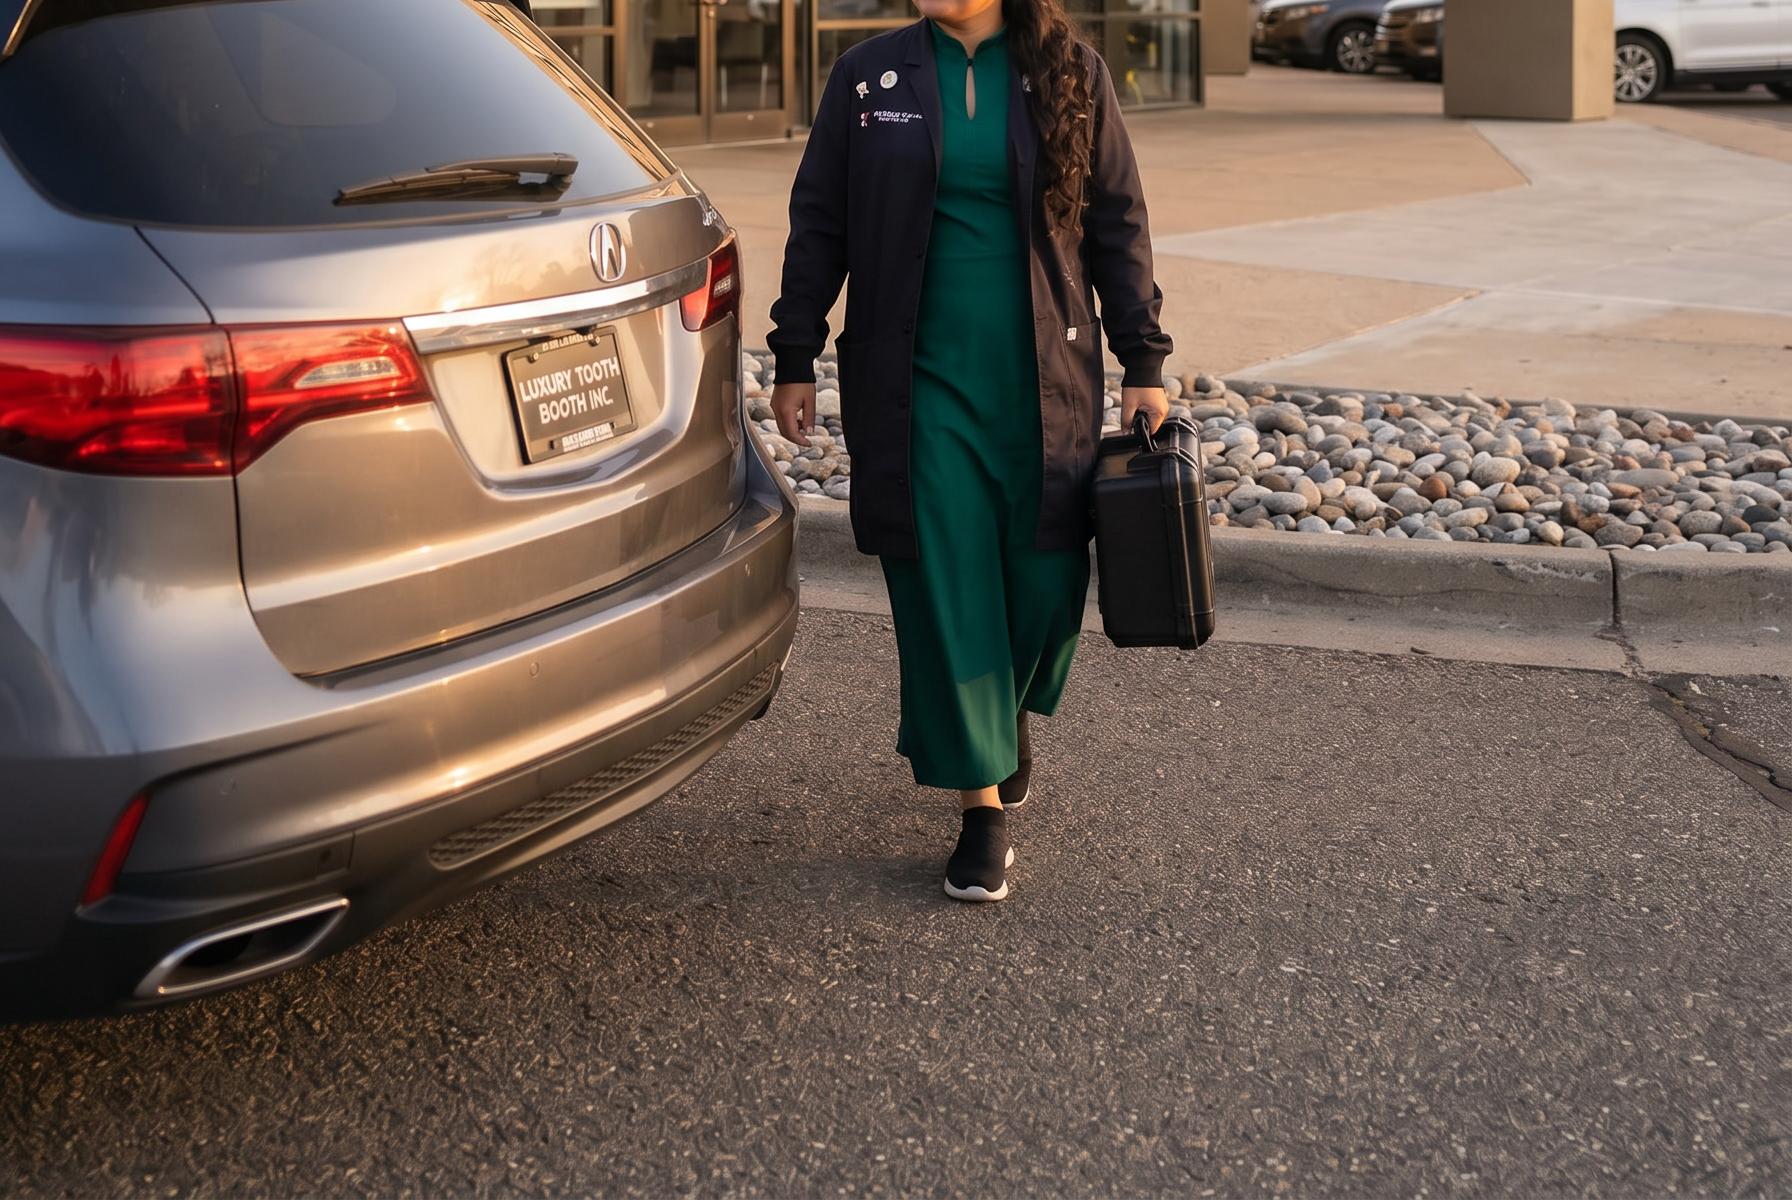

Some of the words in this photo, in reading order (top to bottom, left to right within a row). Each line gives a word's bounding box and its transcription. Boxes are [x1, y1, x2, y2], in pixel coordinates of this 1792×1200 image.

[519, 369, 573, 403] LUXURY
[574, 356, 621, 387] TOOTH
[538, 392, 588, 425] BOOTH
[588, 385, 614, 411] INC.
